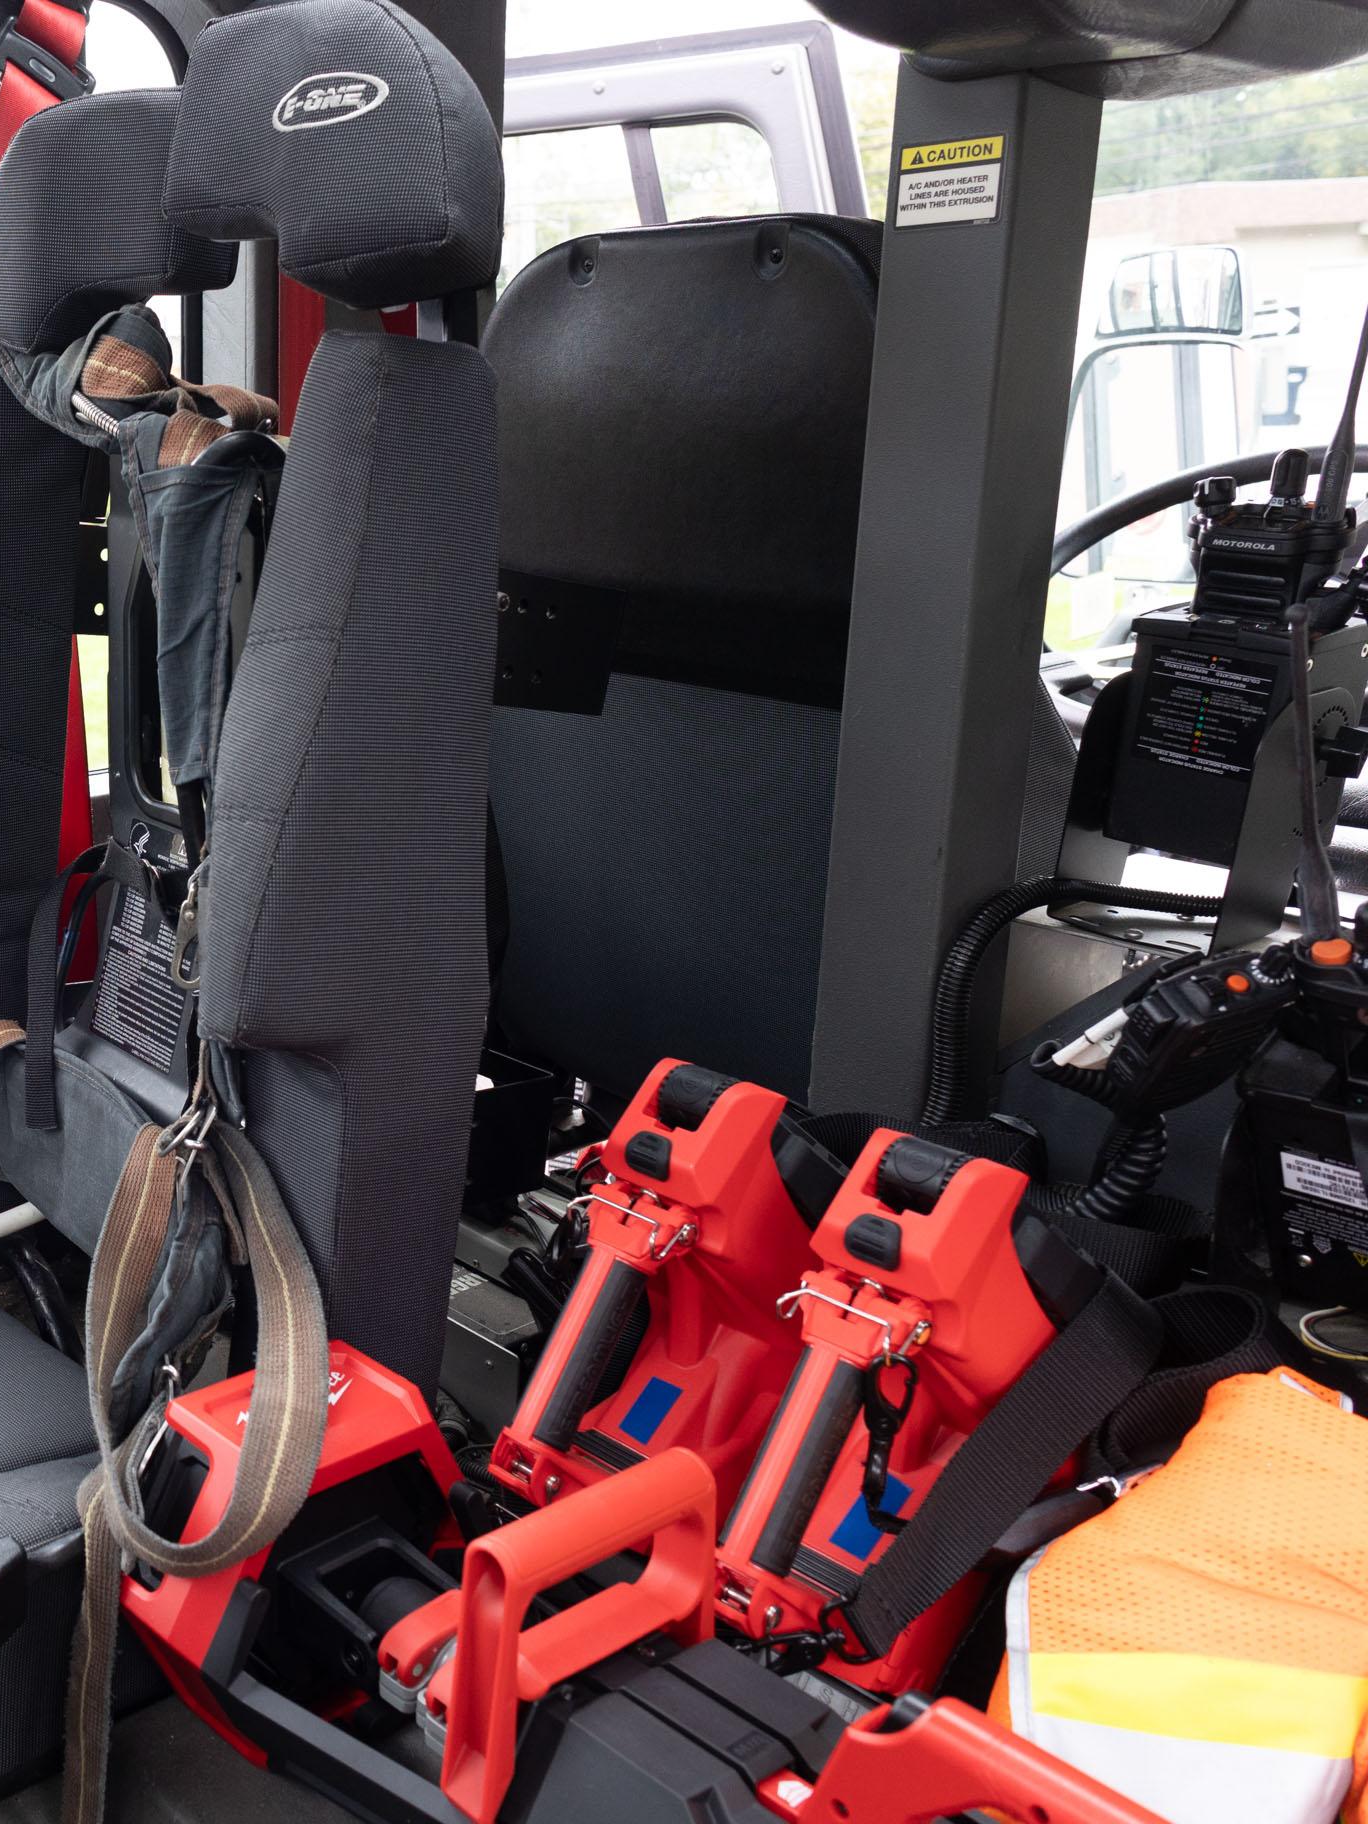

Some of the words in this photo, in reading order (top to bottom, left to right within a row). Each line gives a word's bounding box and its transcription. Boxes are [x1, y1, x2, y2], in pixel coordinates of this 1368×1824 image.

[927, 143, 993, 163] CAUTION
[908, 182, 923, 191] A/C
[923, 178, 955, 189] AND/OR
[956, 174, 989, 185] HEATER
[909, 191, 932, 201] LINES
[934, 189, 950, 198] ARE
[951, 185, 985, 196] HOUSED
[900, 202, 927, 212] WITHIN
[929, 199, 946, 209] THIS
[948, 195, 994, 207] EXTRUSION
[1212, 538, 1276, 551] MOTOROLA
